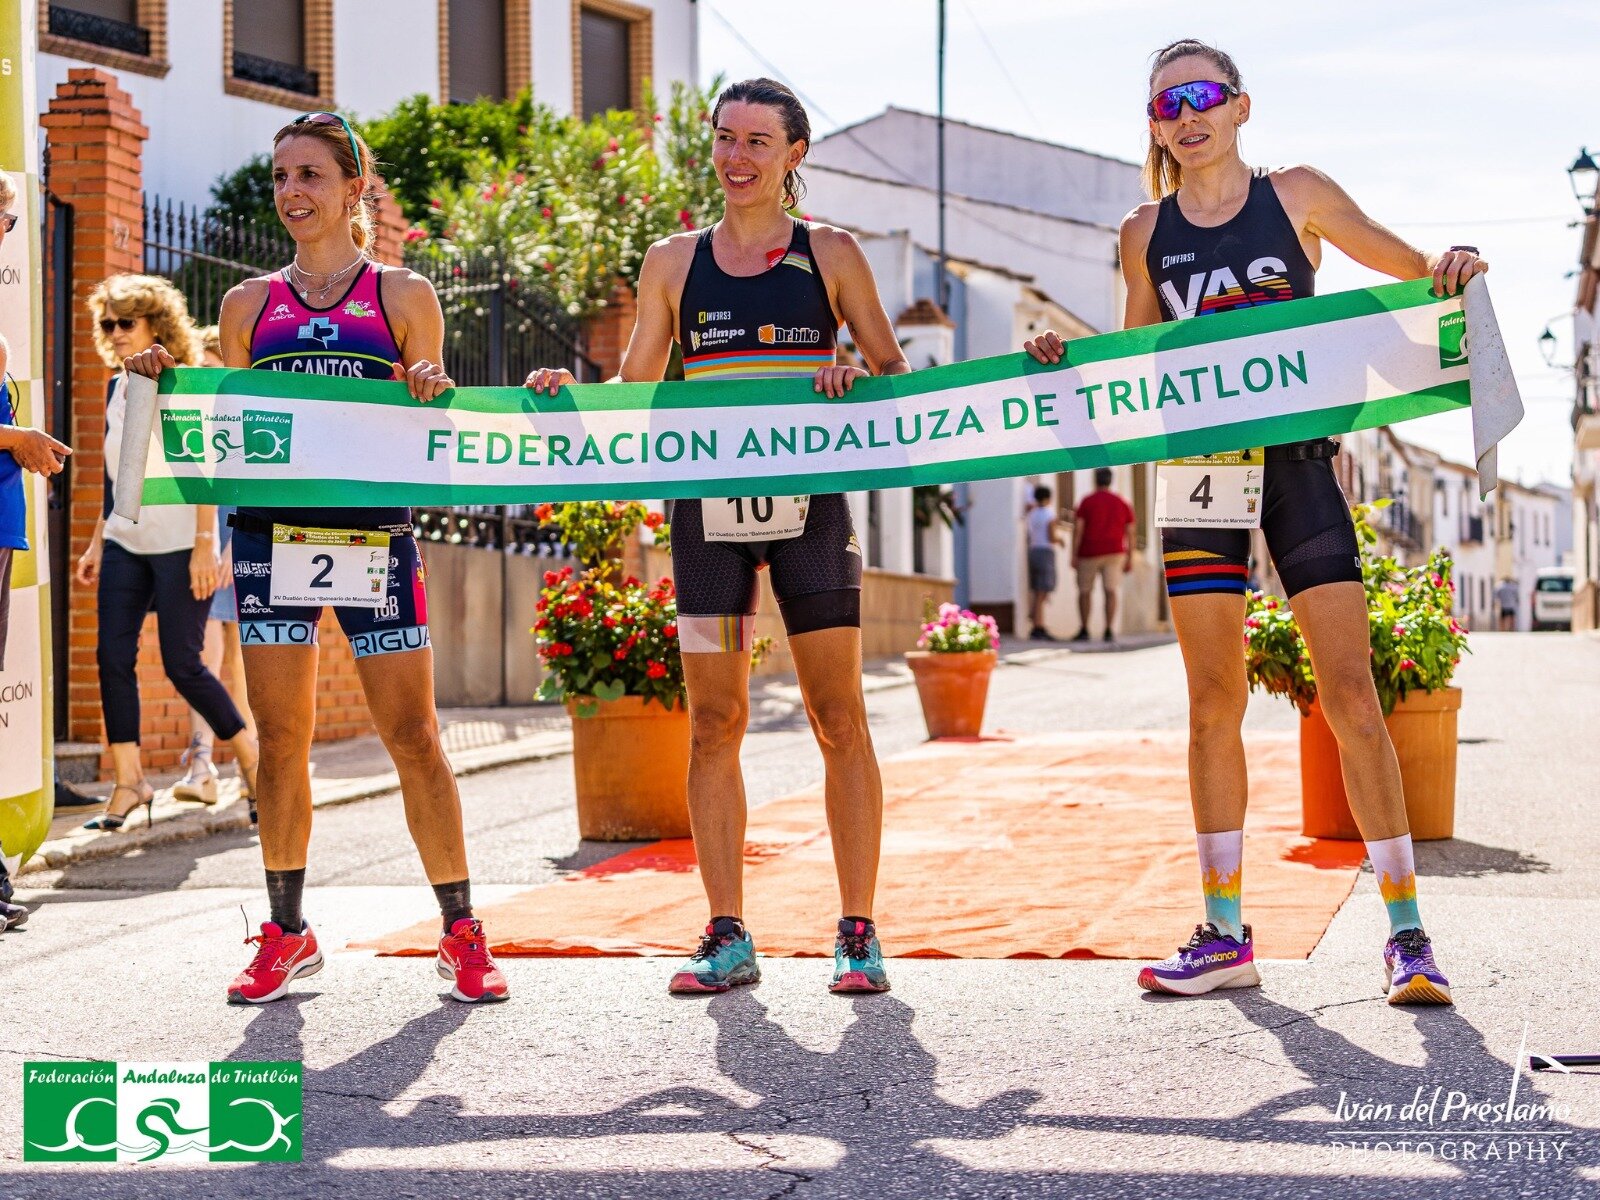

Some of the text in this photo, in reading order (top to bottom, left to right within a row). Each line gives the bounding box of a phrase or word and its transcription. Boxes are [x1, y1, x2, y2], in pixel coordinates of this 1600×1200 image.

[1160, 257, 1294, 320] VAS
[701, 338, 729, 347] deportes
[702, 327, 745, 340] olimpo
[291, 358, 364, 379] CANTOS
[163, 413, 291, 424] Federación Andaluza de Triatlón
[427, 350, 1309, 467] FEDERACION ANDALUZA DE TRIATLON
[1223, 455, 1240, 464] 2023
[1189, 474, 1213, 509] 4
[727, 497, 774, 524] 10
[309, 553, 334, 588] 2
[0, 680, 32, 703] CIÓN
[1204, 950, 1238, 964] balance
